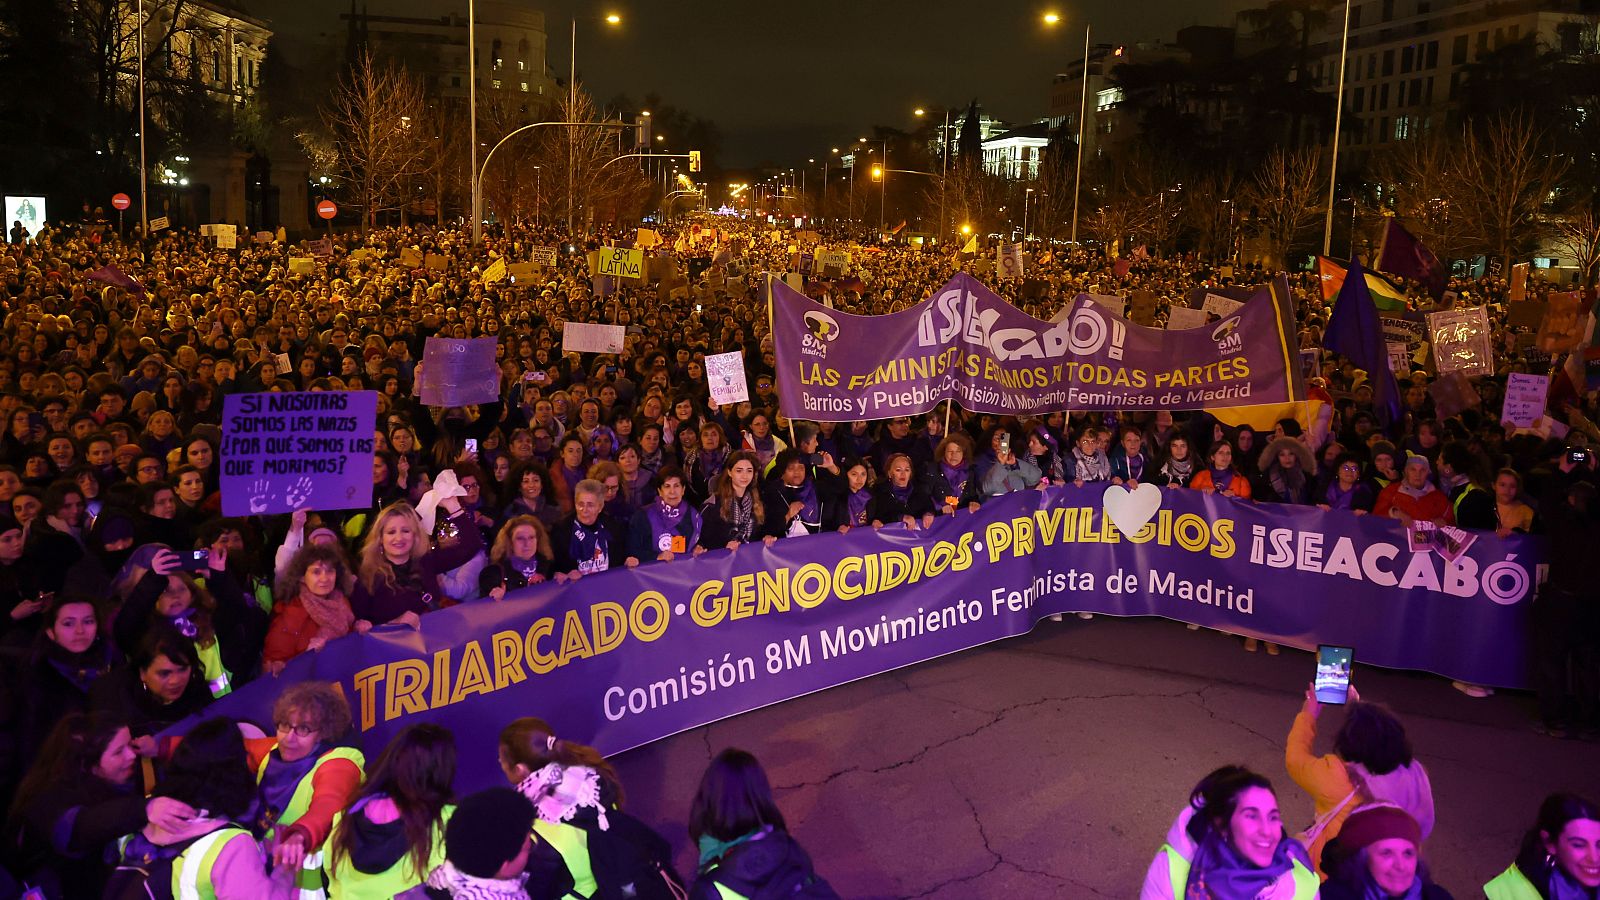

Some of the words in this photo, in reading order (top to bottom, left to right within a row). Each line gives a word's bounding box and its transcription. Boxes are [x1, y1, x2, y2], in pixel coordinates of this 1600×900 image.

[612, 248, 630, 262] 8M
[600, 256, 640, 276] LATINA
[802, 333, 827, 354] 8M
[802, 347, 827, 360] Madrid
[1220, 345, 1242, 356] Madrid
[800, 361, 841, 387] LAS
[848, 347, 980, 391] FEMINISTAS
[1066, 361, 1147, 388] TODAS
[1155, 356, 1250, 388] PARTES
[240, 396, 262, 413] SI
[269, 394, 349, 412] NOSOTRAS
[803, 391, 853, 412] Barrios
[856, 397, 868, 415] y
[873, 384, 941, 409] Pueblos
[942, 374, 1000, 406] Comisión
[1068, 387, 1159, 405] Feminista
[1159, 389, 1181, 405] de
[1186, 382, 1251, 403] Madrid
[230, 416, 286, 434] SOMOS
[290, 416, 314, 432] LAS
[318, 416, 358, 432] NAZIS
[221, 435, 261, 456] ¿POR
[265, 434, 294, 454] QUÉ
[296, 438, 345, 454] SOMOS
[349, 438, 374, 454] LAS
[225, 459, 255, 476] QUE
[263, 455, 348, 475] MORIMOS?
[985, 507, 1236, 564] PRVILEIOS
[603, 653, 756, 722] Comisión
[765, 634, 812, 674] 8M
[820, 599, 984, 660] Movimiento
[1105, 568, 1138, 594] de
[1148, 569, 1254, 615] Madrid
